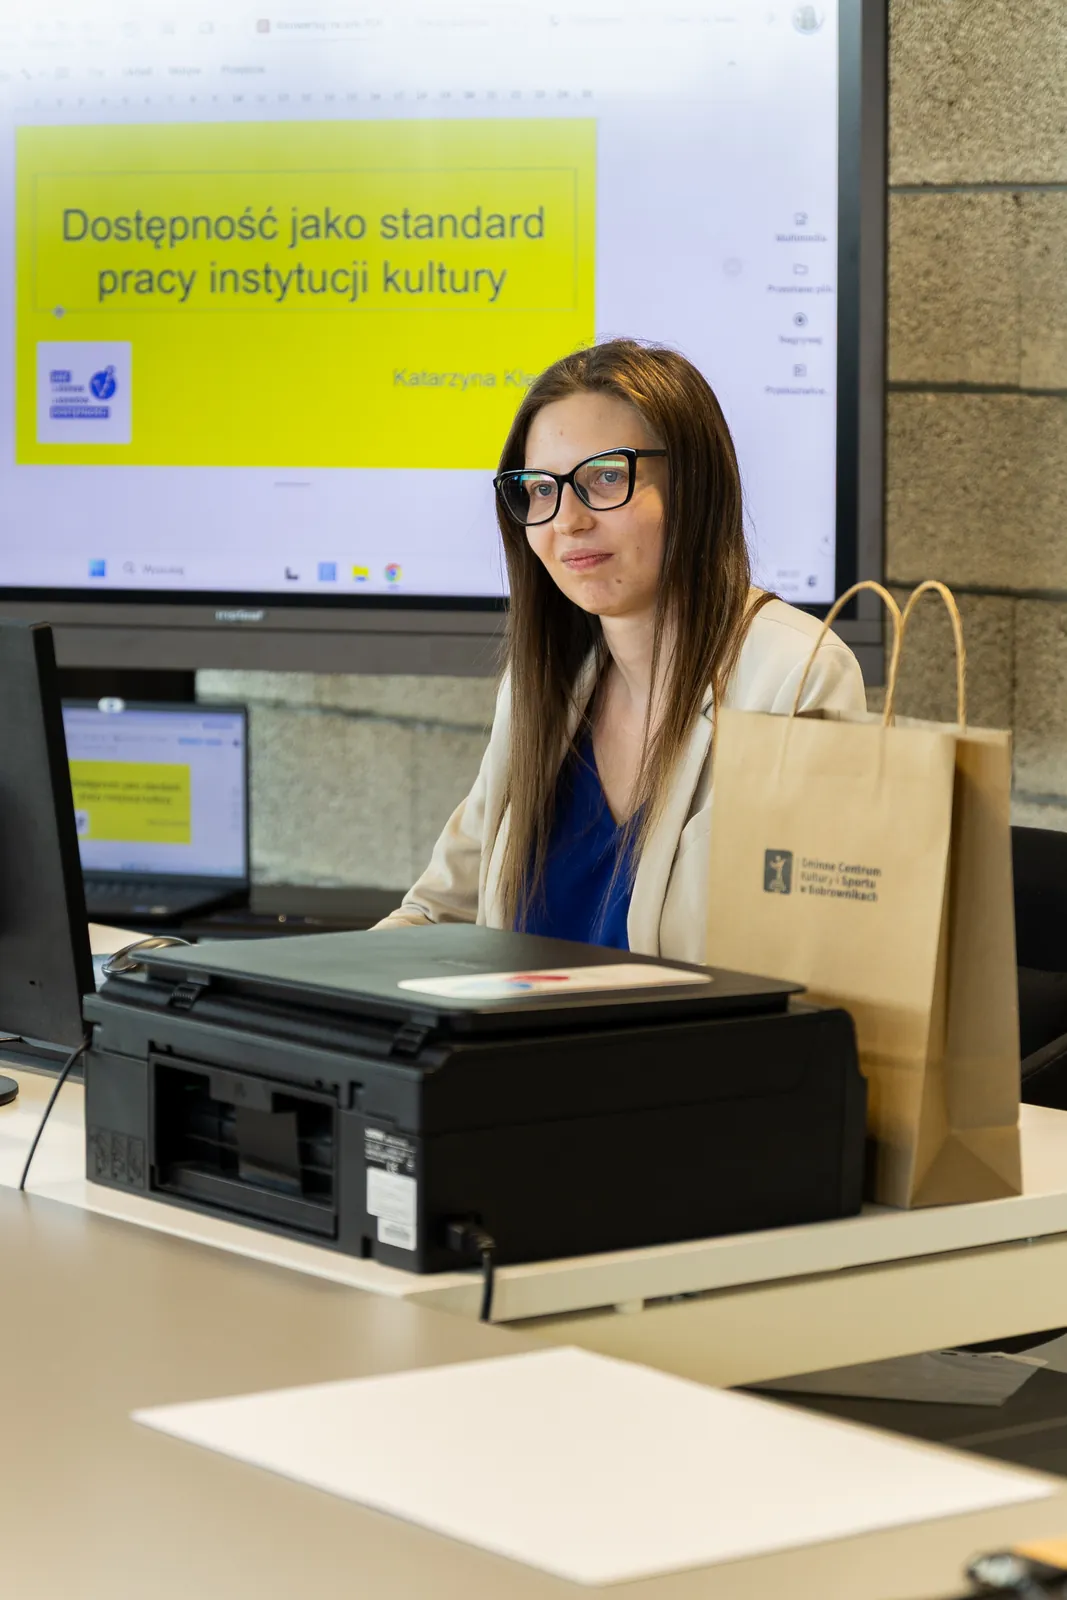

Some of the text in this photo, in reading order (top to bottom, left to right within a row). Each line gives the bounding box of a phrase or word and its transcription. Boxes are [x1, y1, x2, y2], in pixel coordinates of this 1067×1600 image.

[62, 206, 545, 249] Dostępność jako standard
[98, 260, 506, 303] pracy instytucji kultury
[392, 367, 536, 391] Katarzyna Kle
[838, 862, 881, 876] Centrum
[842, 876, 876, 888] Sportu
